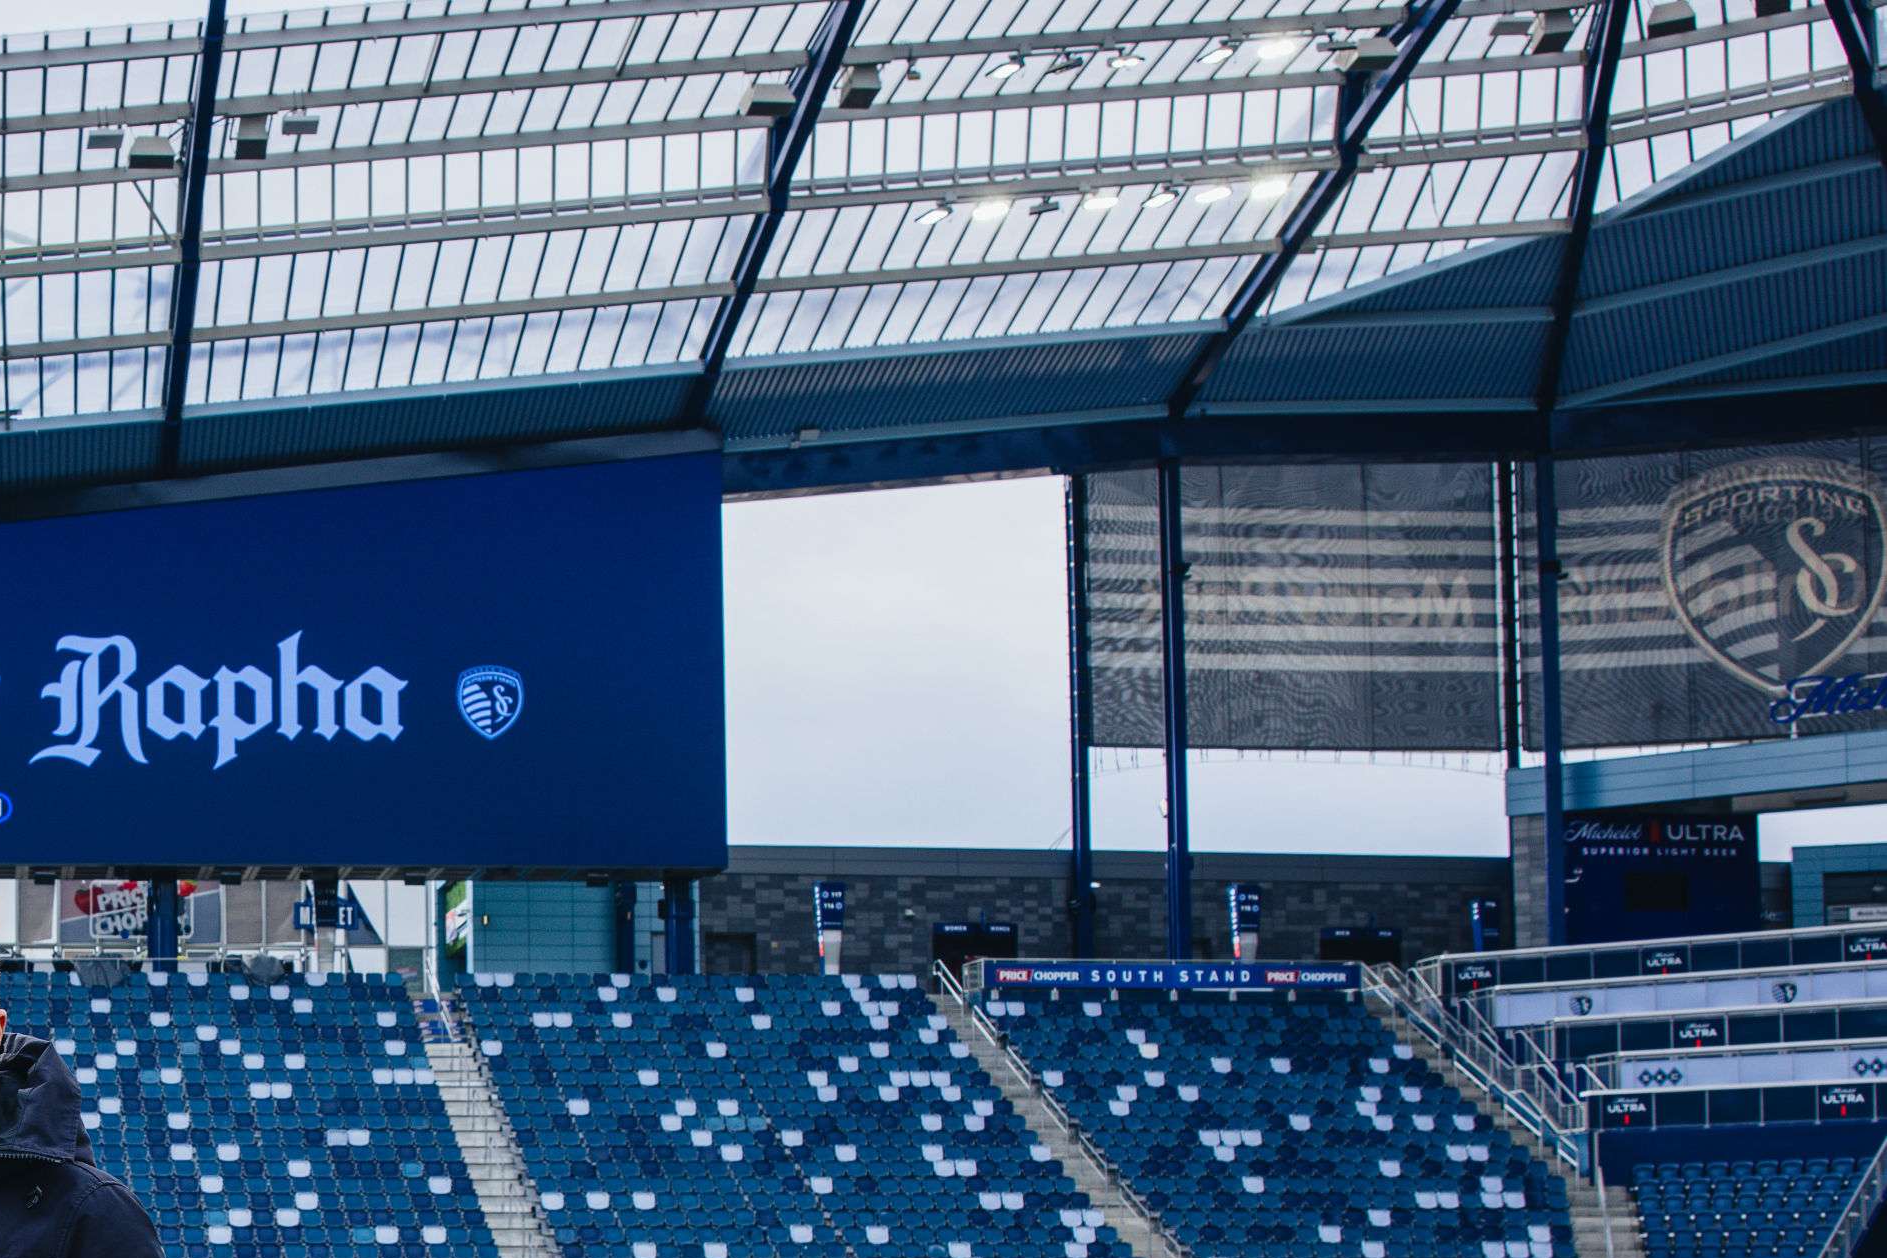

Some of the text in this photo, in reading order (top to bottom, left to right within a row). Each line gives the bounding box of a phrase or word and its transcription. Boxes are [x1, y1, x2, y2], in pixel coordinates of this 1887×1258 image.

[1682, 484, 1869, 528] SPORTING
[28, 629, 410, 771] Rapha
[1667, 824, 1746, 842] ULTRA
[1582, 846, 1650, 856] SUPERIOR
[1656, 847, 1697, 857] LIGHT
[998, 969, 1347, 984] PRICE CHOPPER SOUTH STAND PRICE CHOPPER
[1679, 1028, 1718, 1039] ULTRA
[1822, 1093, 1865, 1105] ULTRA
[1607, 1103, 1647, 1114] ULTRA
